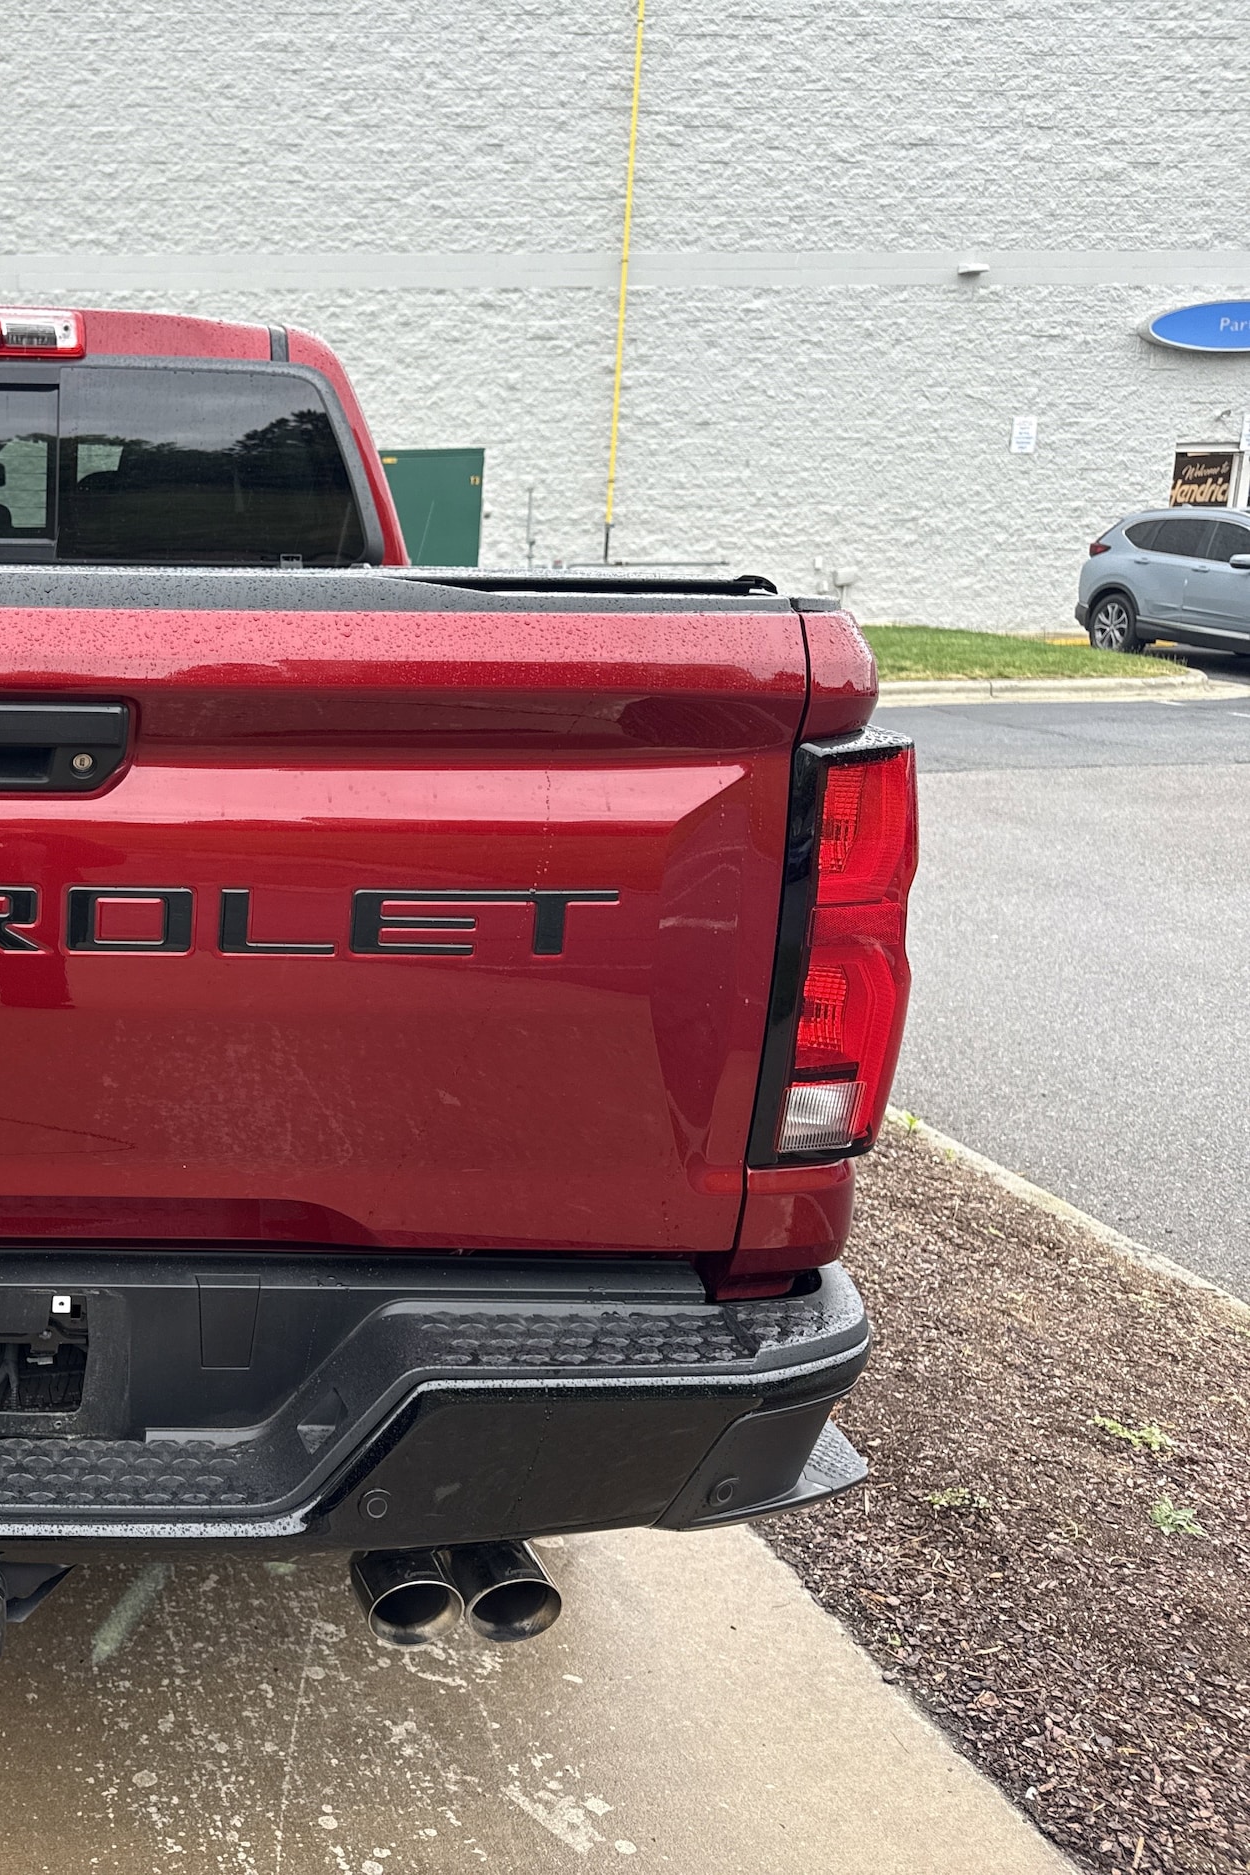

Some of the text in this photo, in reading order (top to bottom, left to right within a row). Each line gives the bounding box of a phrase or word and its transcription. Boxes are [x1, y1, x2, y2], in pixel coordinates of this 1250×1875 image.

[1181, 461, 1230, 480] Welcome to
[1170, 477, 1229, 507] Hendric
